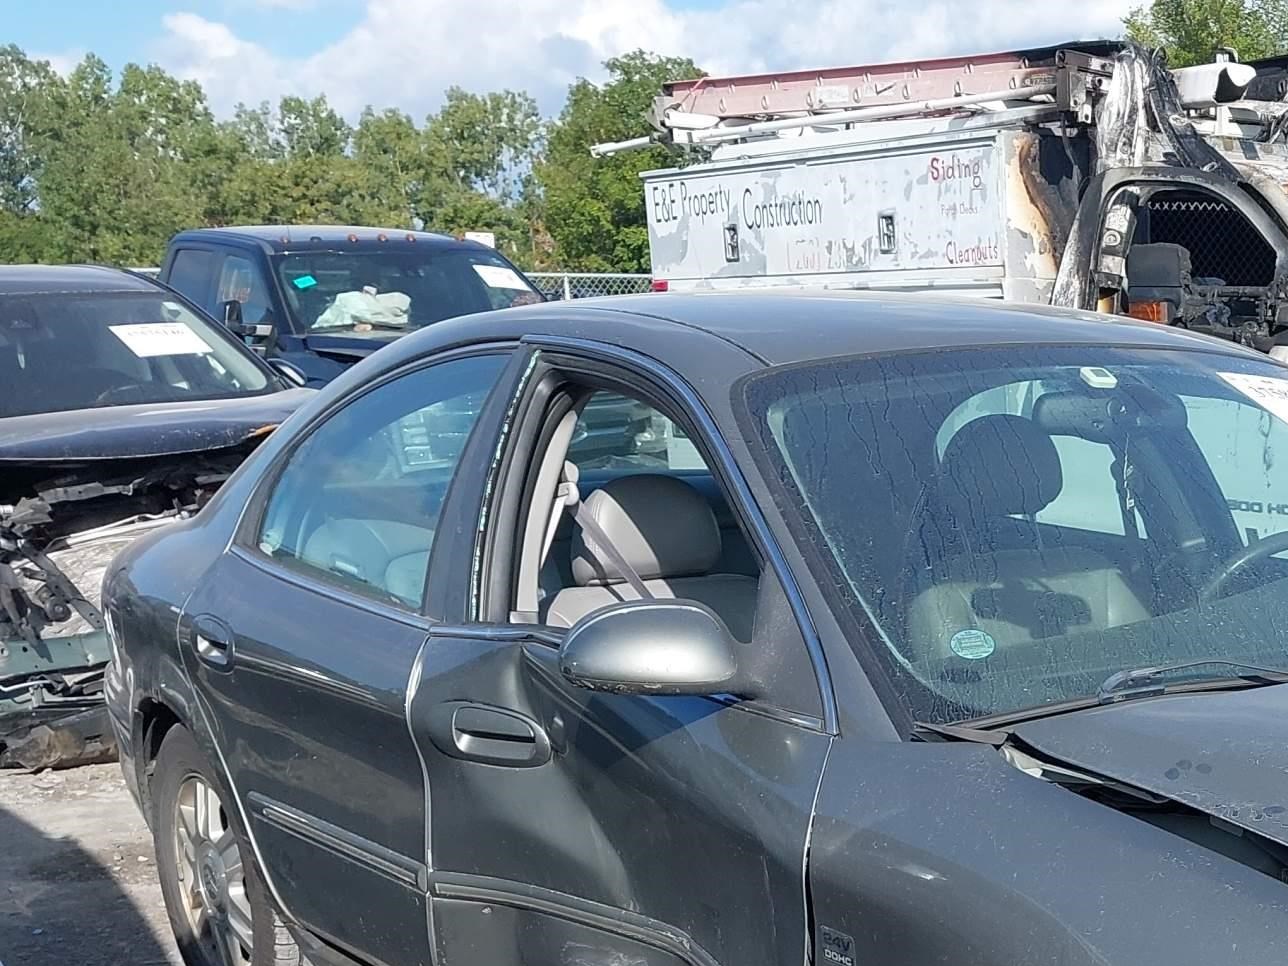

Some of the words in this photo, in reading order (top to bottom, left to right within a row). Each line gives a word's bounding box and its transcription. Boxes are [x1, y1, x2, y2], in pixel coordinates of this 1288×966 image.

[930, 154, 982, 189] Siding
[652, 183, 678, 223] E&E
[680, 182, 730, 225] Property
[743, 188, 822, 229] Construction
[946, 240, 998, 265] Cleanouts
[823, 931, 850, 951] 24V
[824, 949, 852, 966] DOHC
